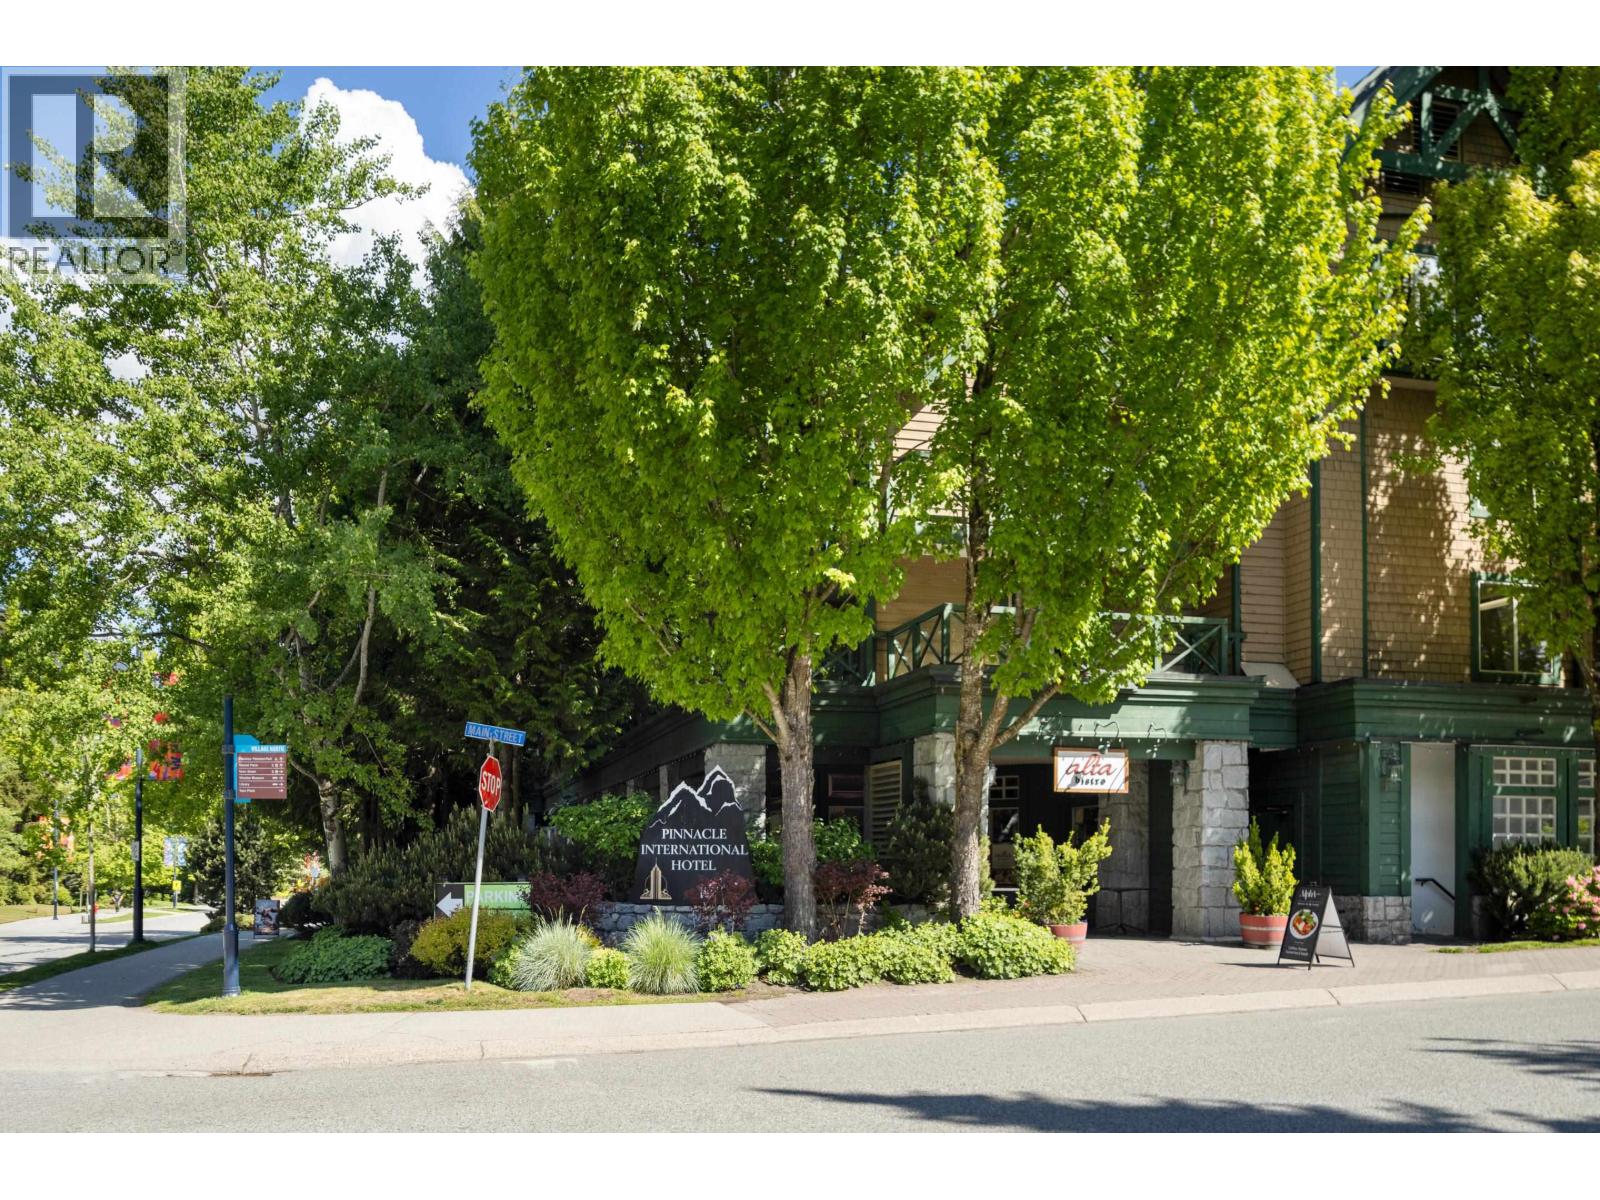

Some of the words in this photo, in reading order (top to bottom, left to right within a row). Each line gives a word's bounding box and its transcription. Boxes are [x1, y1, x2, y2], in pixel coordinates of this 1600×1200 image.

[467, 724, 490, 738] MAIN
[494, 728, 523, 743] STREET
[1064, 754, 1116, 776] alta
[481, 770, 501, 796] STOP
[661, 828, 727, 839] PINNACLE
[640, 844, 749, 855] INTERNATIONAL
[671, 860, 717, 871] HOTEL
[466, 890, 521, 903] PRKIN
